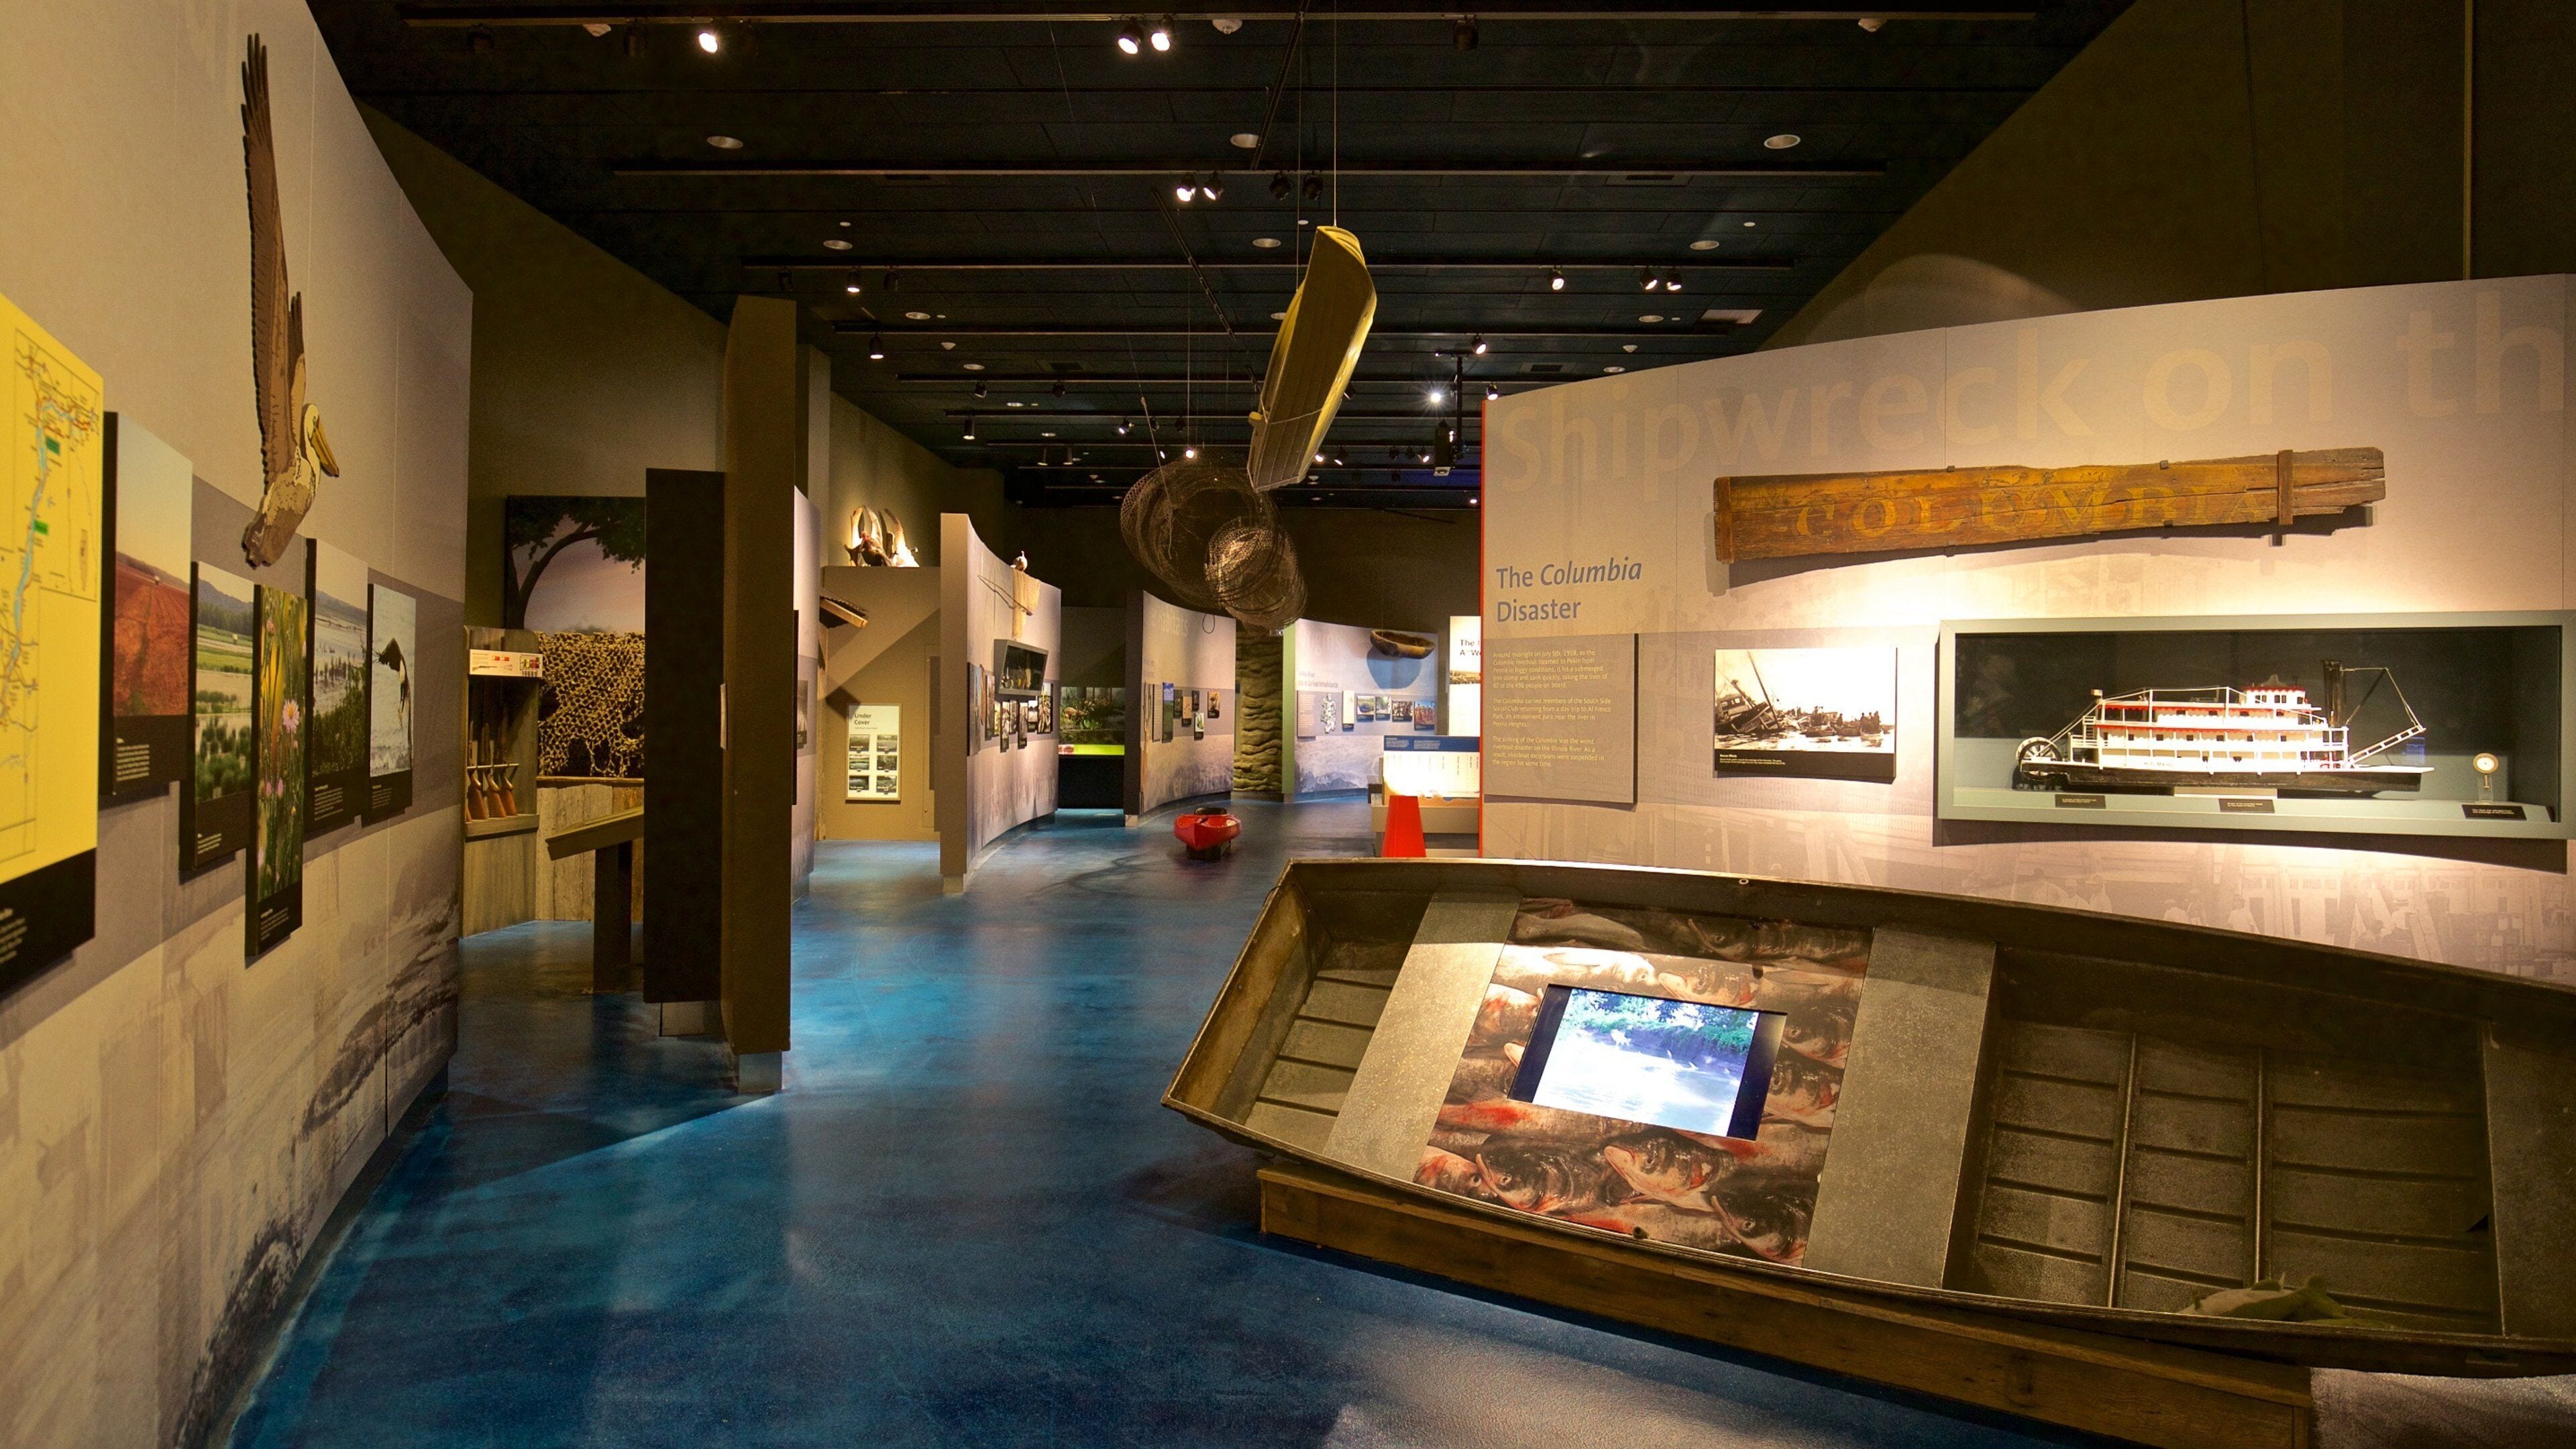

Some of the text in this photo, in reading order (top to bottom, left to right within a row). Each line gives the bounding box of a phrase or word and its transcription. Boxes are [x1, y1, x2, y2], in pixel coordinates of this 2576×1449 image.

[2143, 339, 2333, 431] on
[1496, 556, 1642, 588] The Columbia
[1497, 598, 1581, 623] Disaster
[1460, 639, 1474, 647] The
